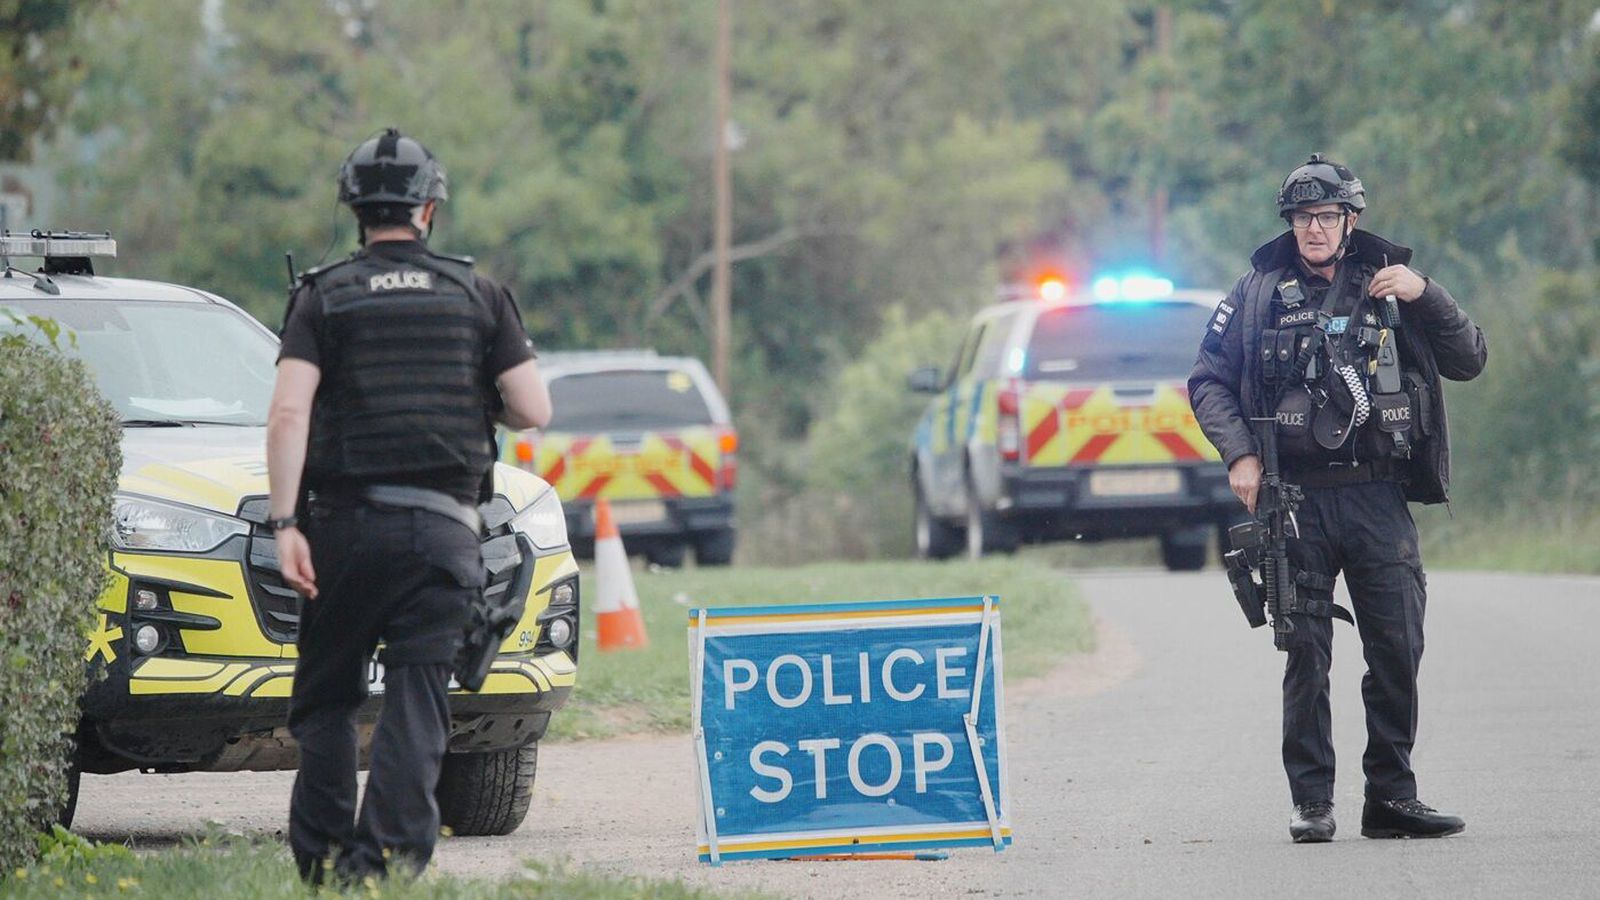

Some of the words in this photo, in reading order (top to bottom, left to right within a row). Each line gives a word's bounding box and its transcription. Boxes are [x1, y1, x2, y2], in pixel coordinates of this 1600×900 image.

[370, 270, 430, 291] POLICE
[1280, 311, 1315, 325] POLICE
[1276, 412, 1304, 426] POLICE
[1381, 406, 1411, 422] POLICE
[723, 647, 970, 711] POLICE
[749, 733, 954, 803] STOP
